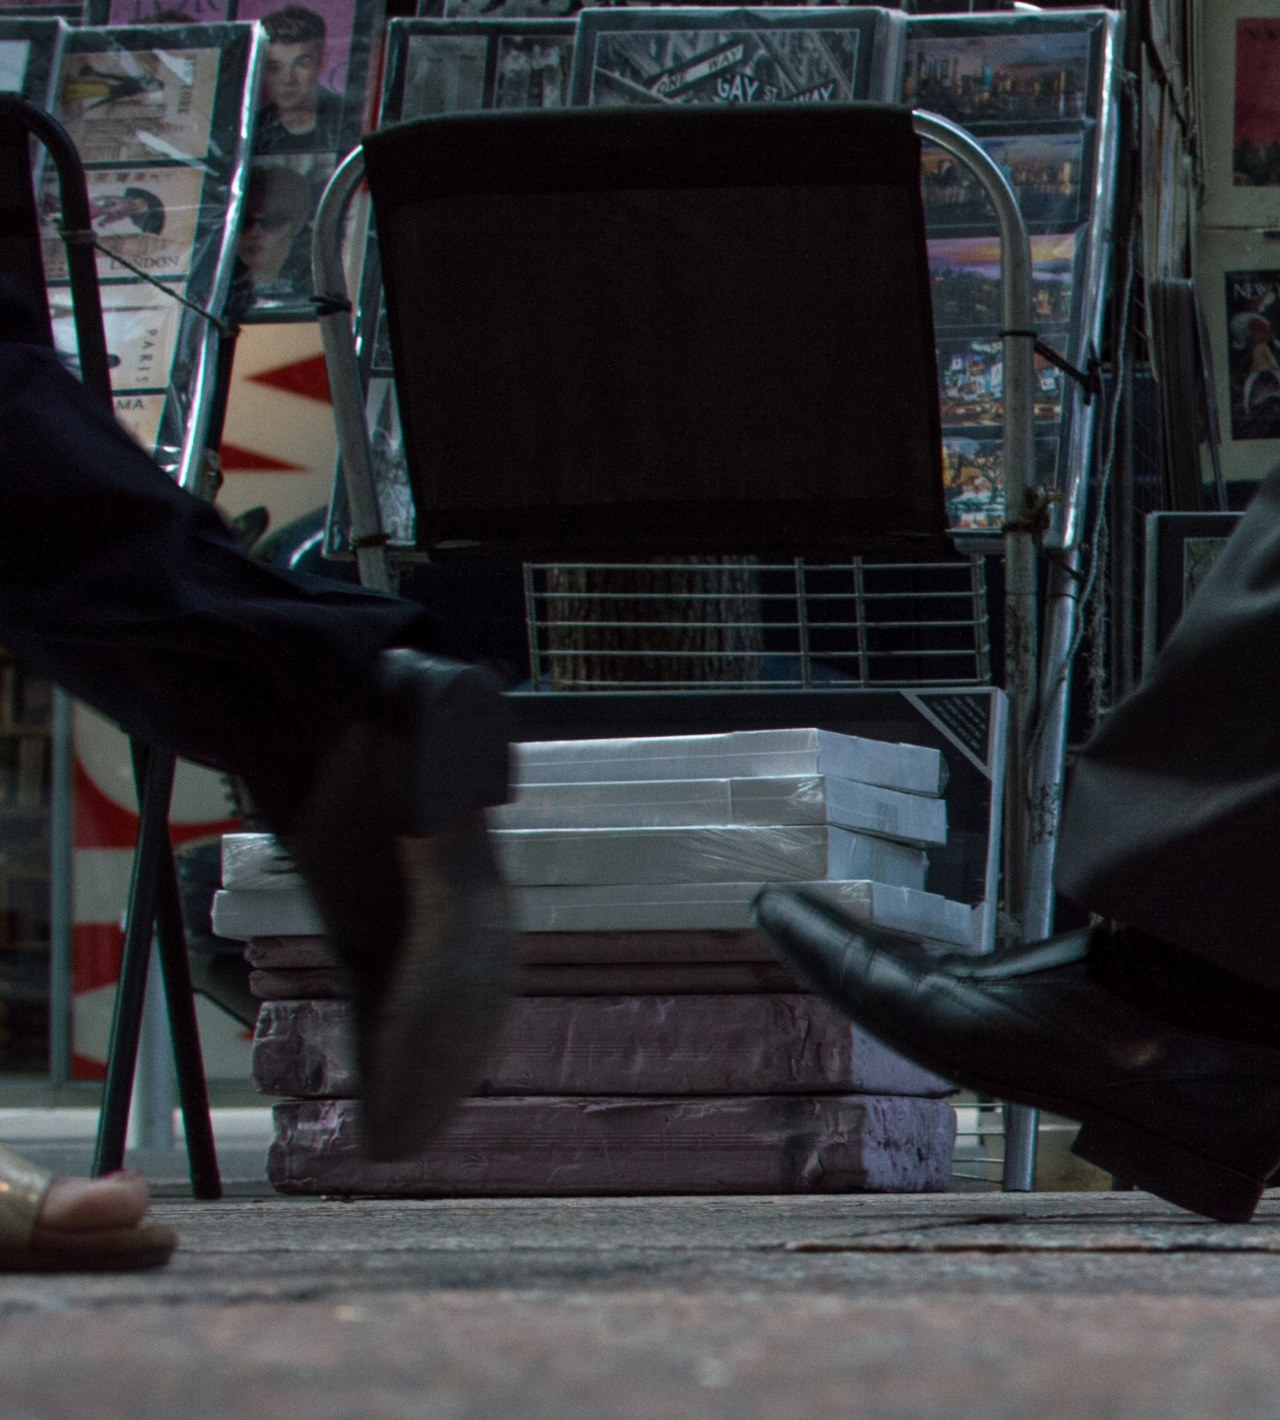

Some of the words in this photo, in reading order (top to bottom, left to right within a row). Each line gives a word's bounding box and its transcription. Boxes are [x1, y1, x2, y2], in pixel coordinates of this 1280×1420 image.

[656, 74, 686, 94] ONE
[708, 50, 739, 74] WAY
[717, 73, 759, 100] GAY
[135, 329, 158, 383] PARIS
